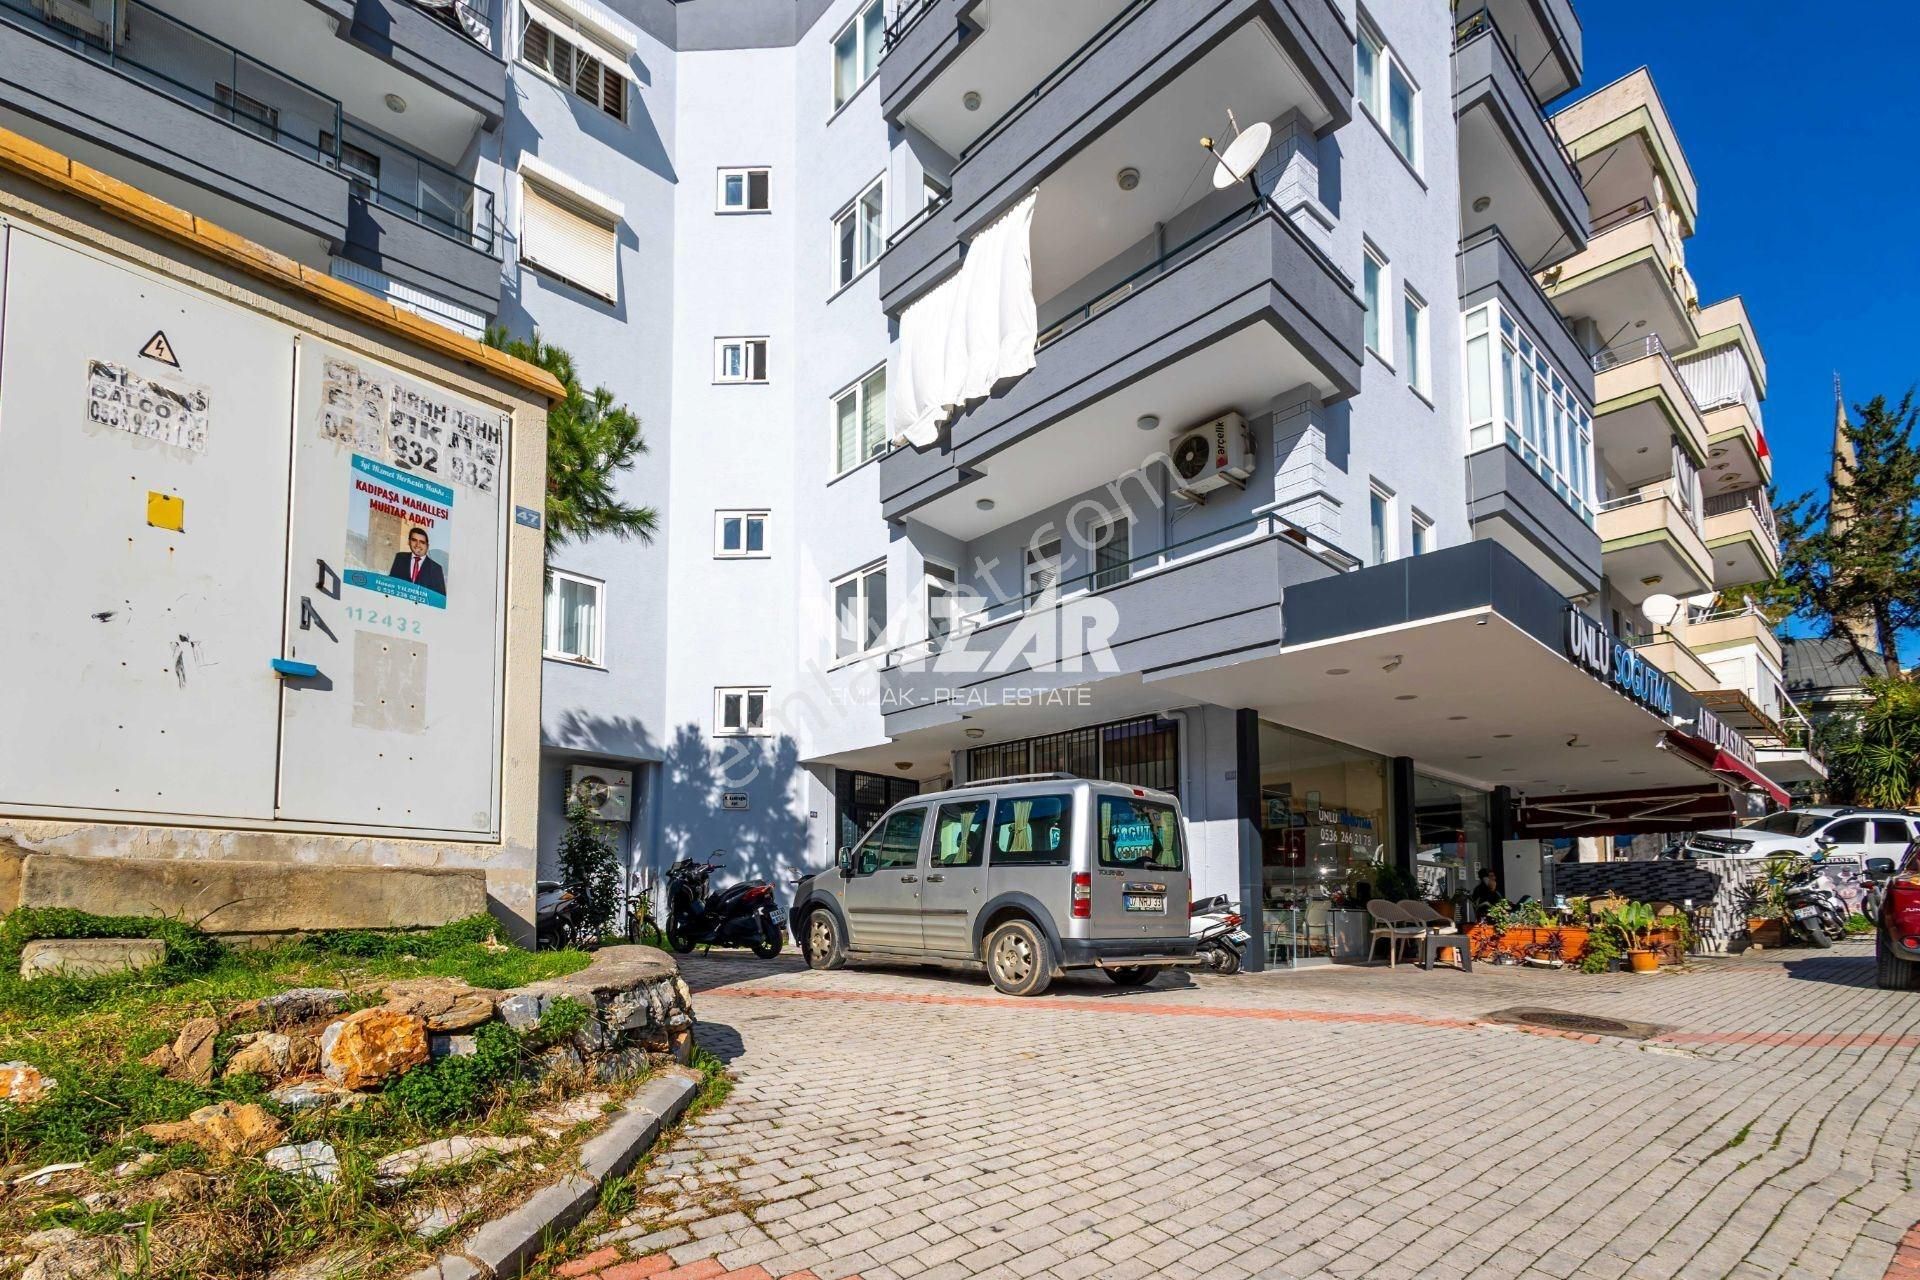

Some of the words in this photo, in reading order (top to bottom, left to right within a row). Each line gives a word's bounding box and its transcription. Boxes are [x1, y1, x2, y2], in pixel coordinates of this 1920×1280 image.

[393, 435, 438, 472] 932
[1215, 420, 1226, 455] arçelik
[356, 480, 400, 503] KADIPAŞA
[402, 496, 449, 520] MAHALLESİ
[369, 499, 407, 520] MUHTAR
[409, 512, 435, 528] ADAYI
[1570, 603, 1610, 675] ÜNLÜ
[1614, 644, 1672, 717] SOĞUTMA
